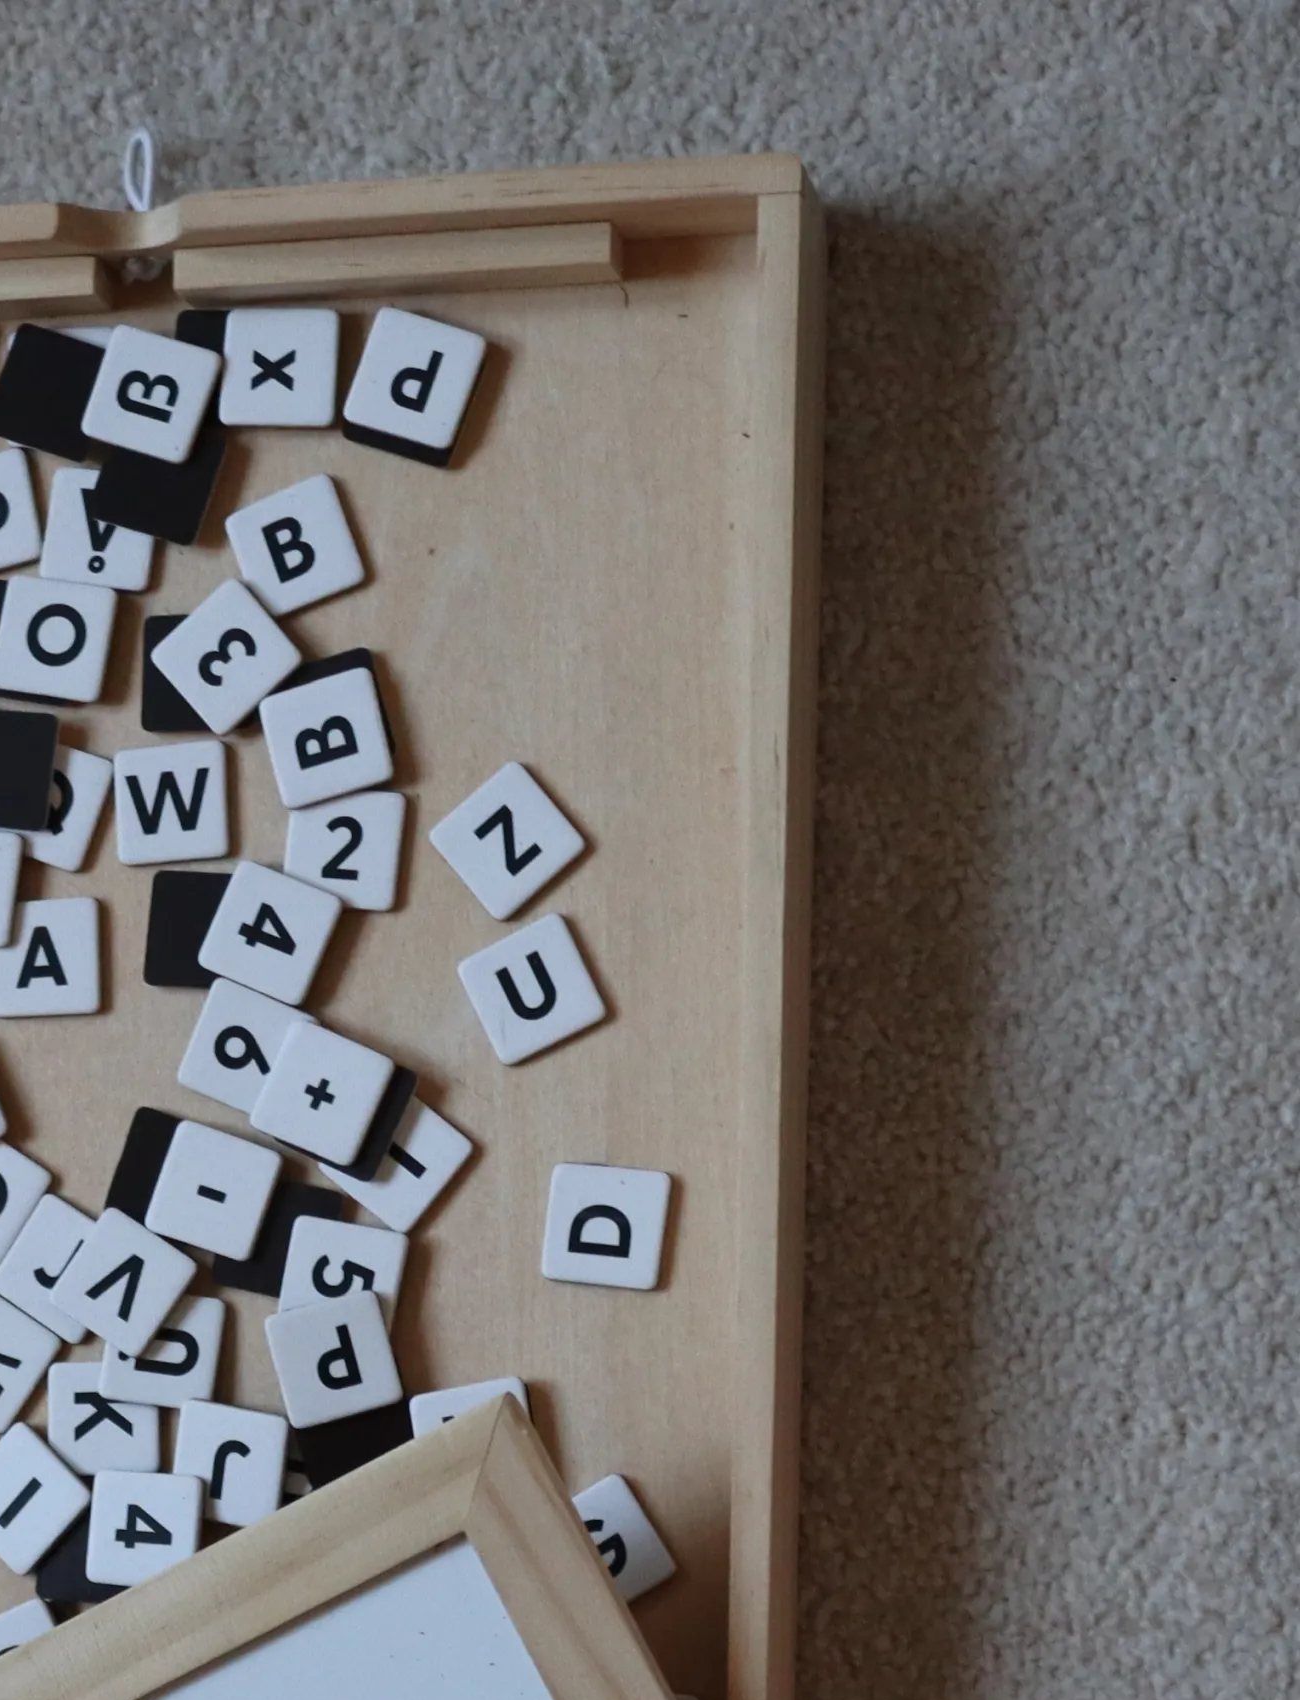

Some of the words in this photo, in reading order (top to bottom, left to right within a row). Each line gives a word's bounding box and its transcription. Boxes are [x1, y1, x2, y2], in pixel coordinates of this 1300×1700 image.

[262, 517, 315, 583] B
[295, 716, 358, 769] B
[126, 768, 209, 834] W
[322, 816, 362, 880] 2
[475, 805, 541, 876] Z
[16, 926, 68, 989] A
[239, 903, 296, 955] 4
[496, 952, 556, 1020] U
[568, 1205, 631, 1258] D
[86, 1255, 144, 1321] V
[312, 1255, 374, 1297] 5
[75, 1392, 132, 1440] K
[210, 1440, 251, 1500] J
[116, 1505, 172, 1548] 4
